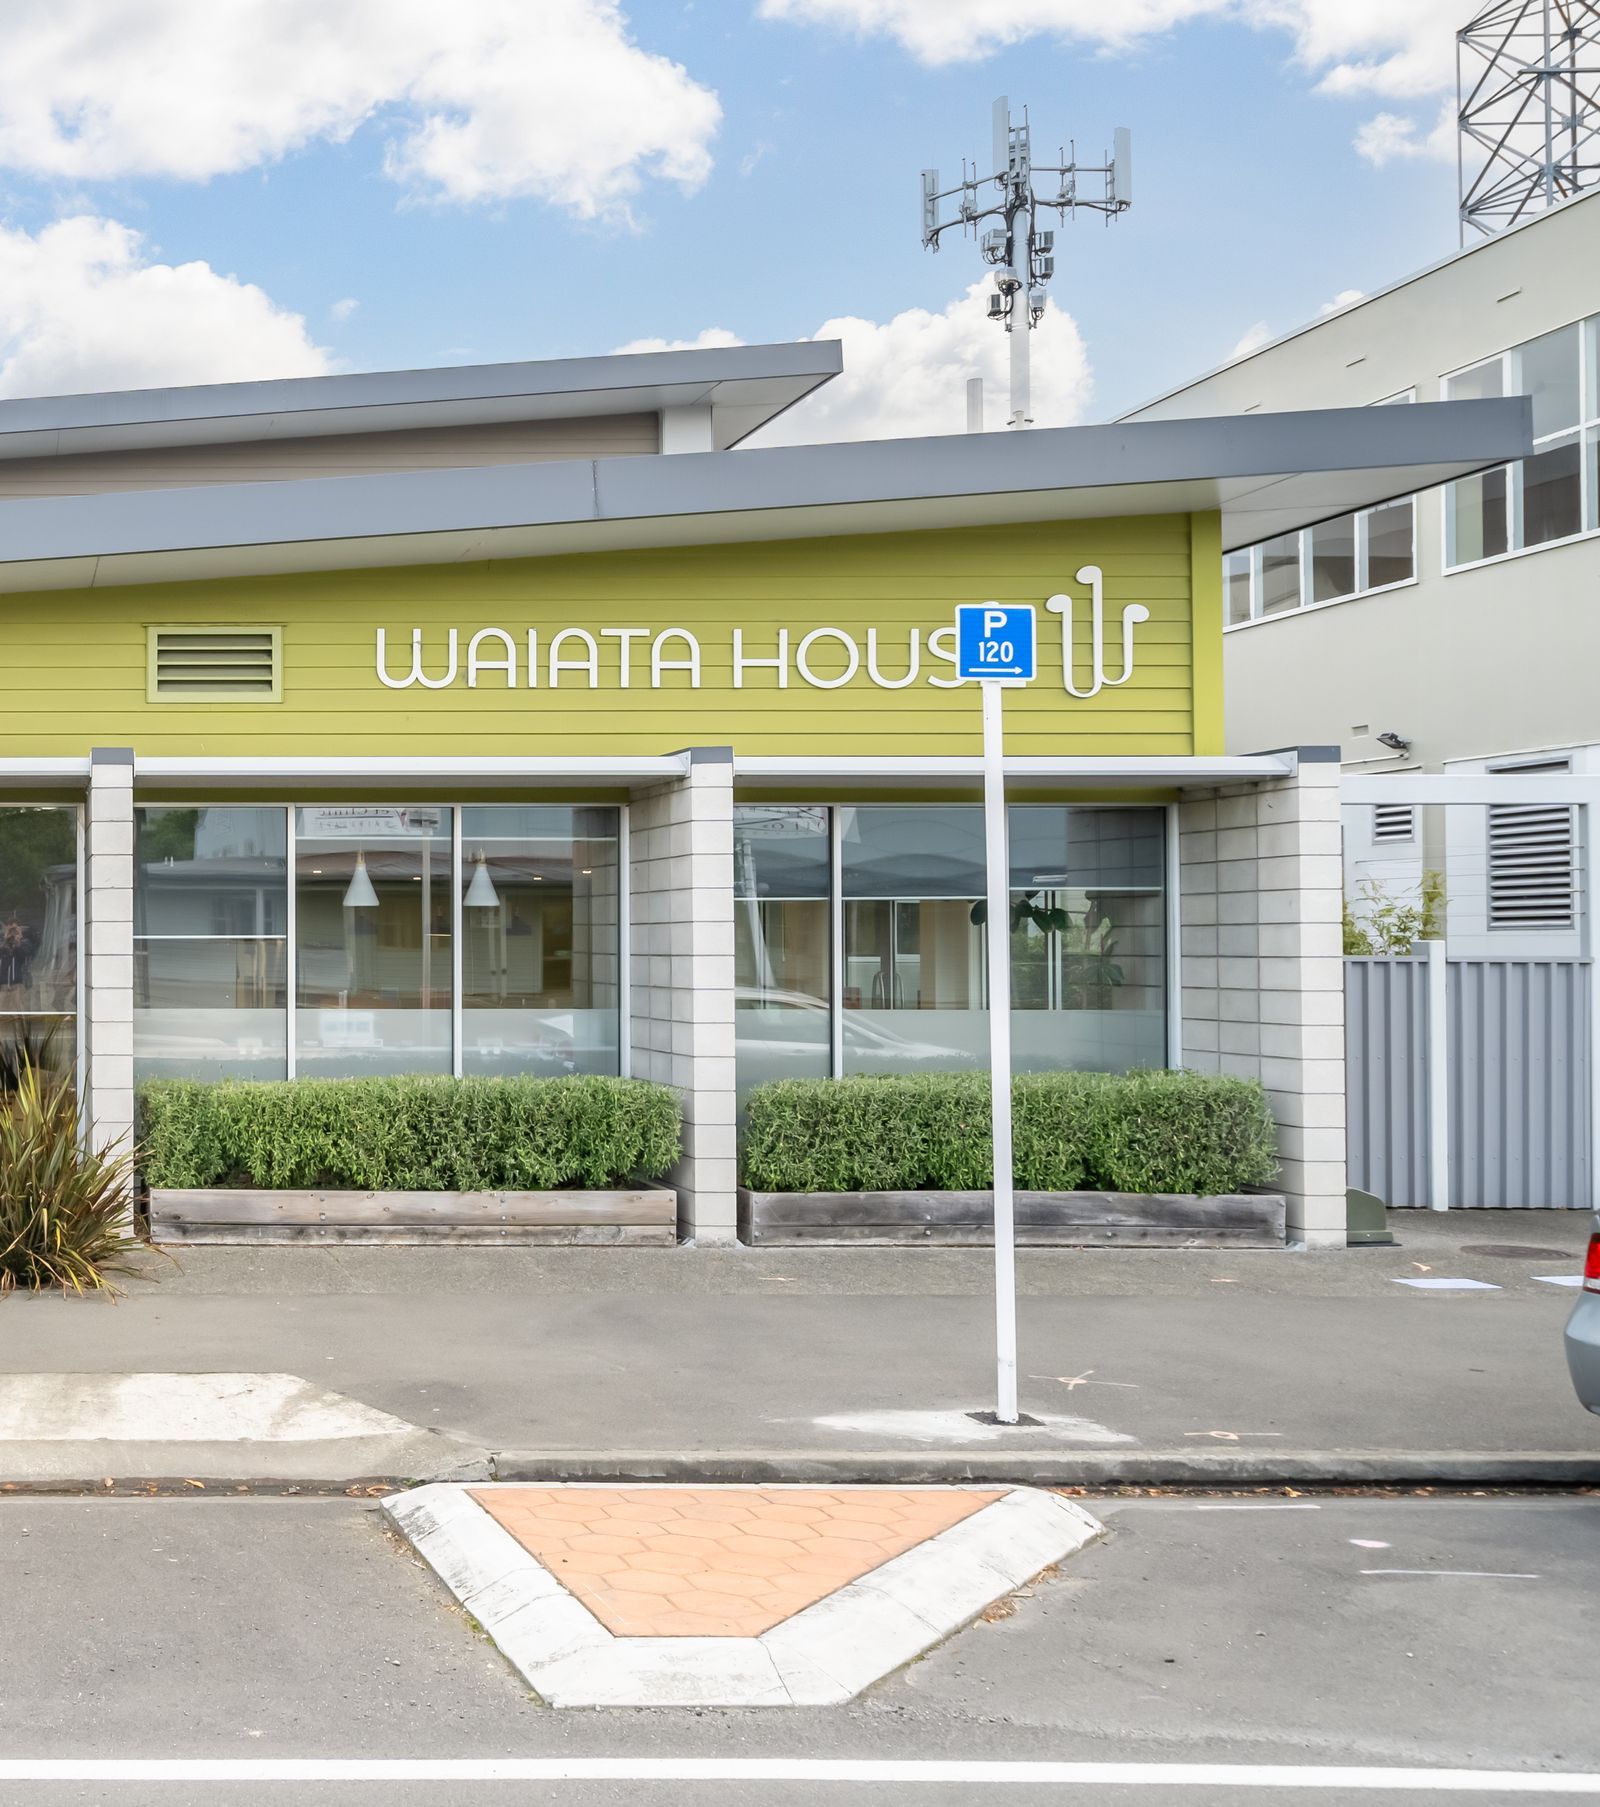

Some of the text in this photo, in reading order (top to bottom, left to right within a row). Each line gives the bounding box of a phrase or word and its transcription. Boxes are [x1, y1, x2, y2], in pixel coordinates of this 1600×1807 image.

[984, 610, 1008, 638] P
[375, 626, 1027, 689] WAIATA HOUS
[978, 641, 1014, 663] 120
